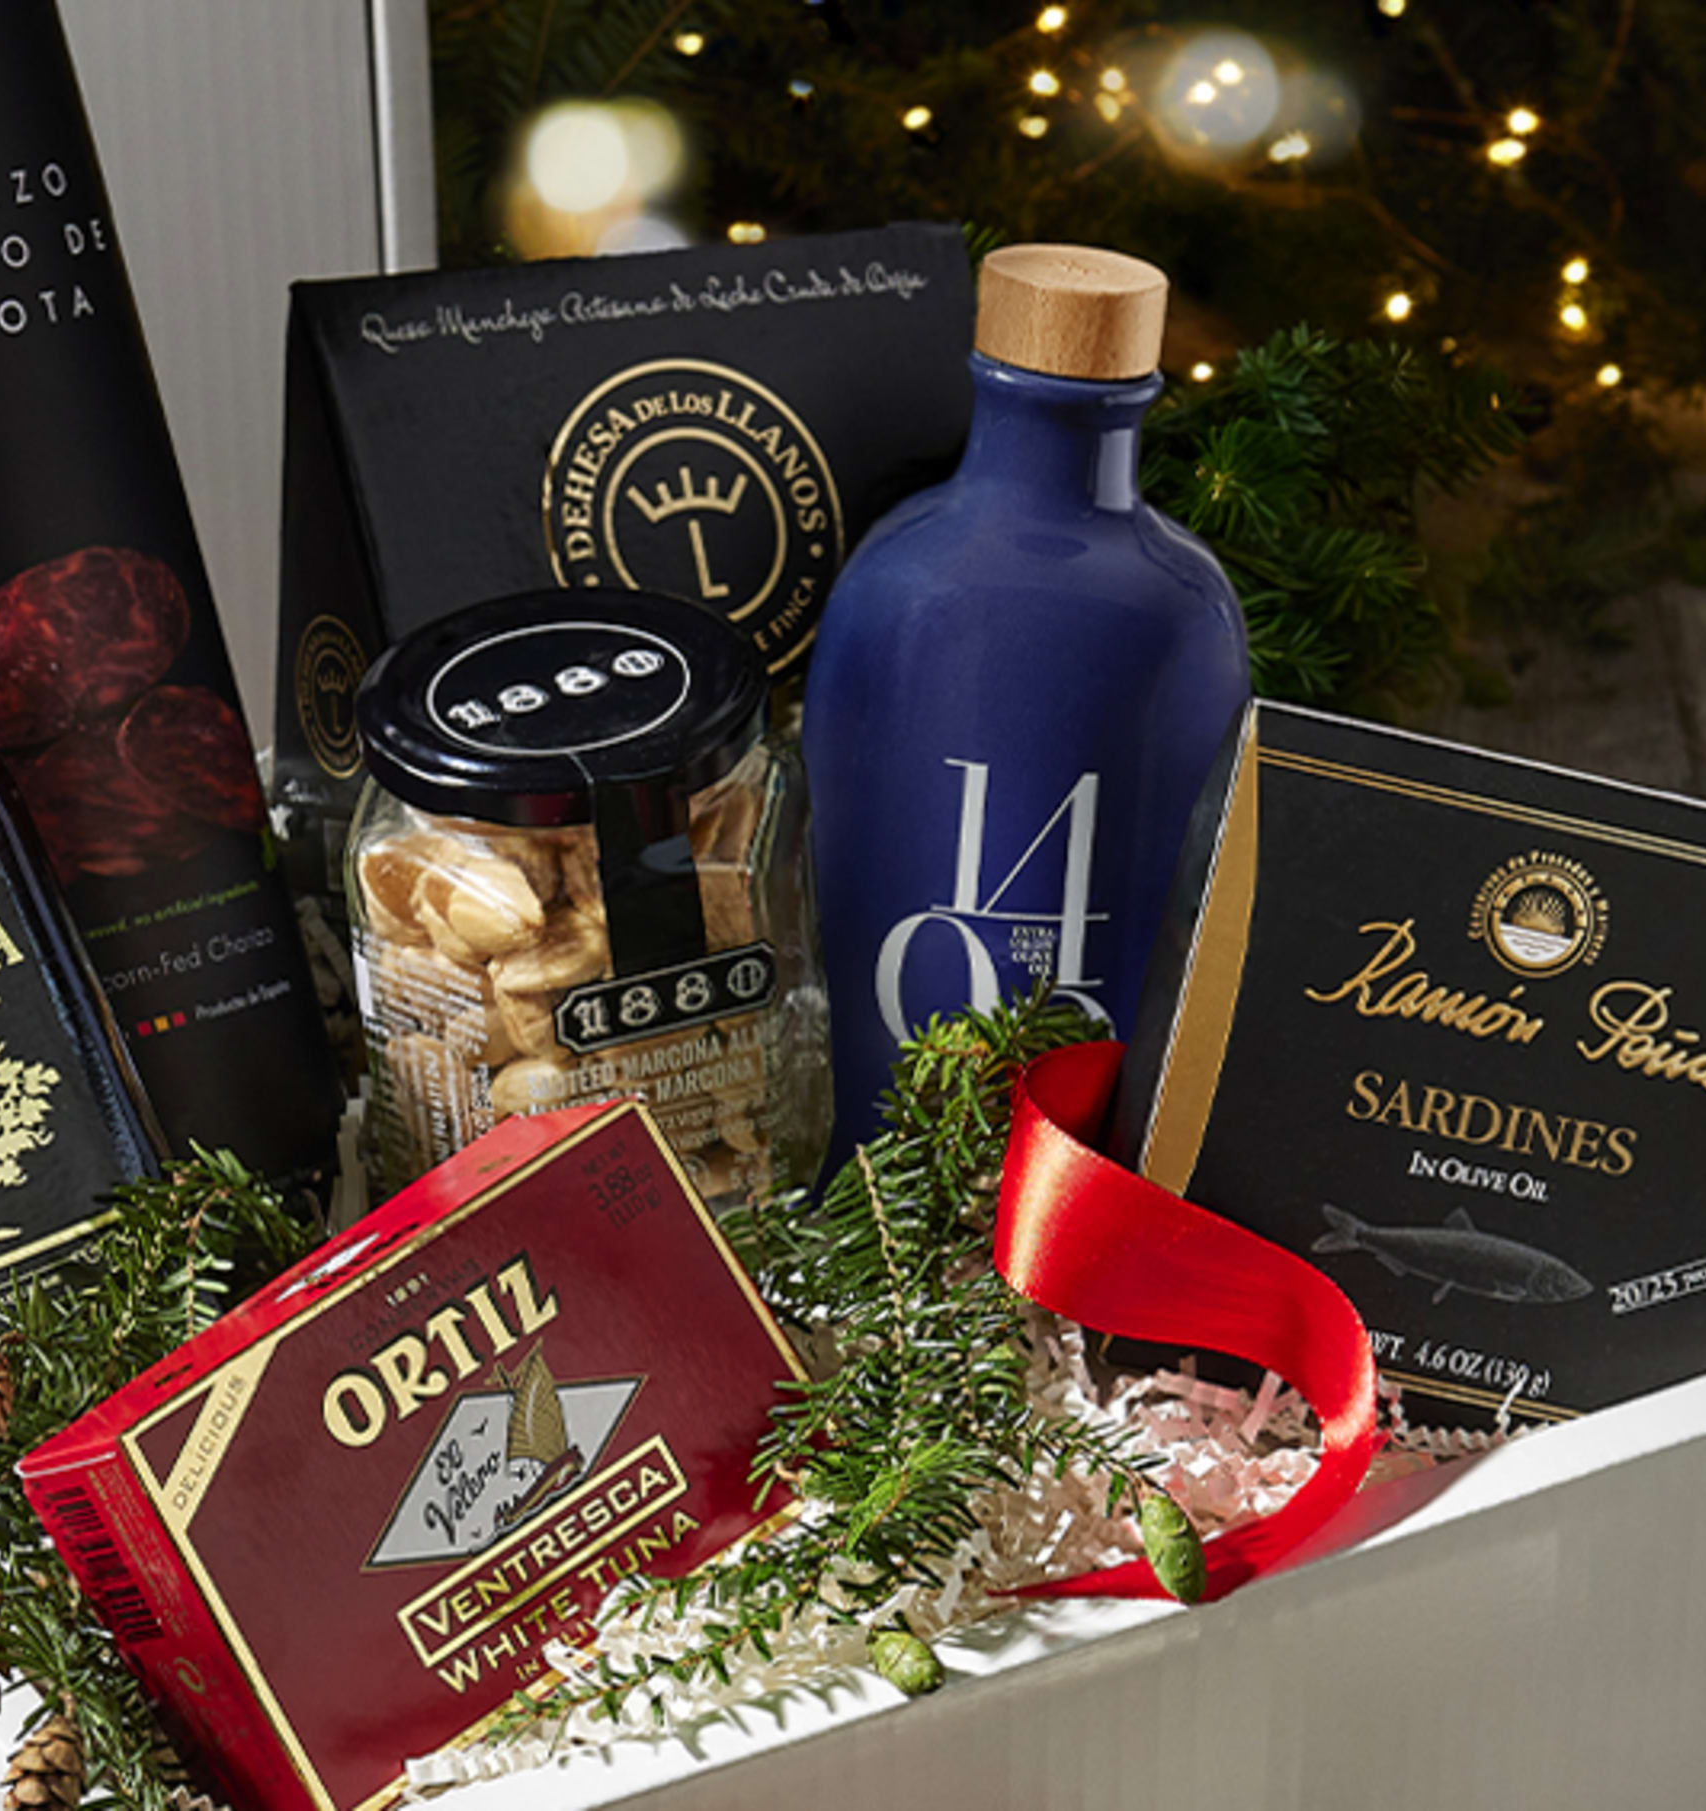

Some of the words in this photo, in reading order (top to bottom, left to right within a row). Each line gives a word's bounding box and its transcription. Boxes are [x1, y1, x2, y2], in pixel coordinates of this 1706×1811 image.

[64, 217, 108, 257] DE
[561, 405, 639, 562] DEHESA
[632, 395, 670, 424] DE
[668, 390, 714, 416] LOS
[714, 389, 828, 534] LLANOS
[101, 941, 204, 994] corn-Fed
[572, 957, 768, 1039] 1880
[1305, 917, 1544, 1045] Ramón
[621, 1033, 722, 1078] MARCONA
[656, 1057, 756, 1103] MARCONA
[1346, 1069, 1638, 1177] SARDINES
[323, 1249, 560, 1448] ORTIZ
[1448, 1348, 1484, 1378] OZ
[173, 1375, 245, 1511] DELICIOUS
[415, 1465, 668, 1635] VENTRESCA
[437, 1586, 581, 1693] WHITE
[579, 1509, 700, 1593] TUNA
